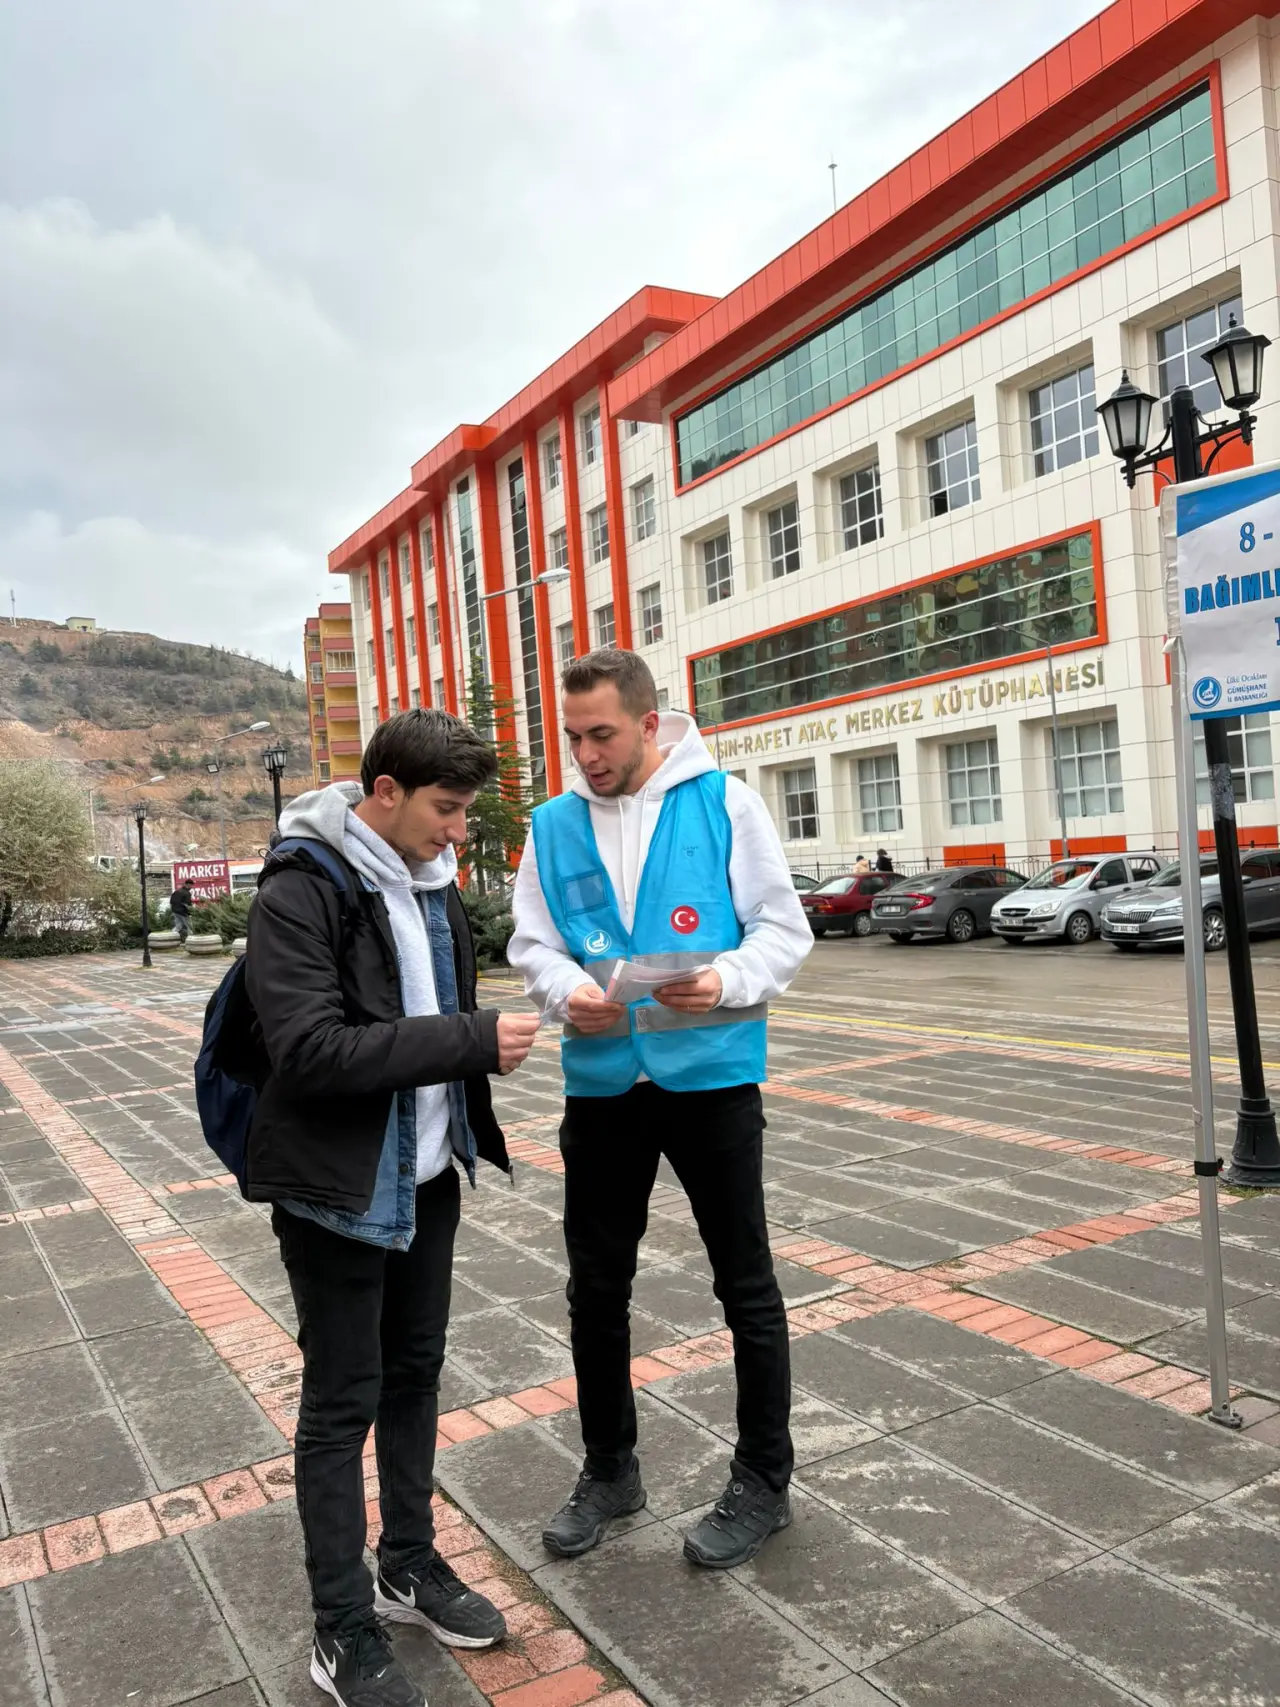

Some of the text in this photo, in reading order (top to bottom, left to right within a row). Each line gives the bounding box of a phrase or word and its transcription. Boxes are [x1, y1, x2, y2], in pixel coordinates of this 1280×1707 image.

[1239, 521, 1256, 553] 8
[798, 717, 839, 742] ATAÇ
[845, 698, 924, 735] MERKEZ
[932, 655, 1104, 717] KÜTÜPHANESİ
[1227, 683, 1267, 694] GÜMÜŞHANE
[178, 863, 226, 880] MARKET
